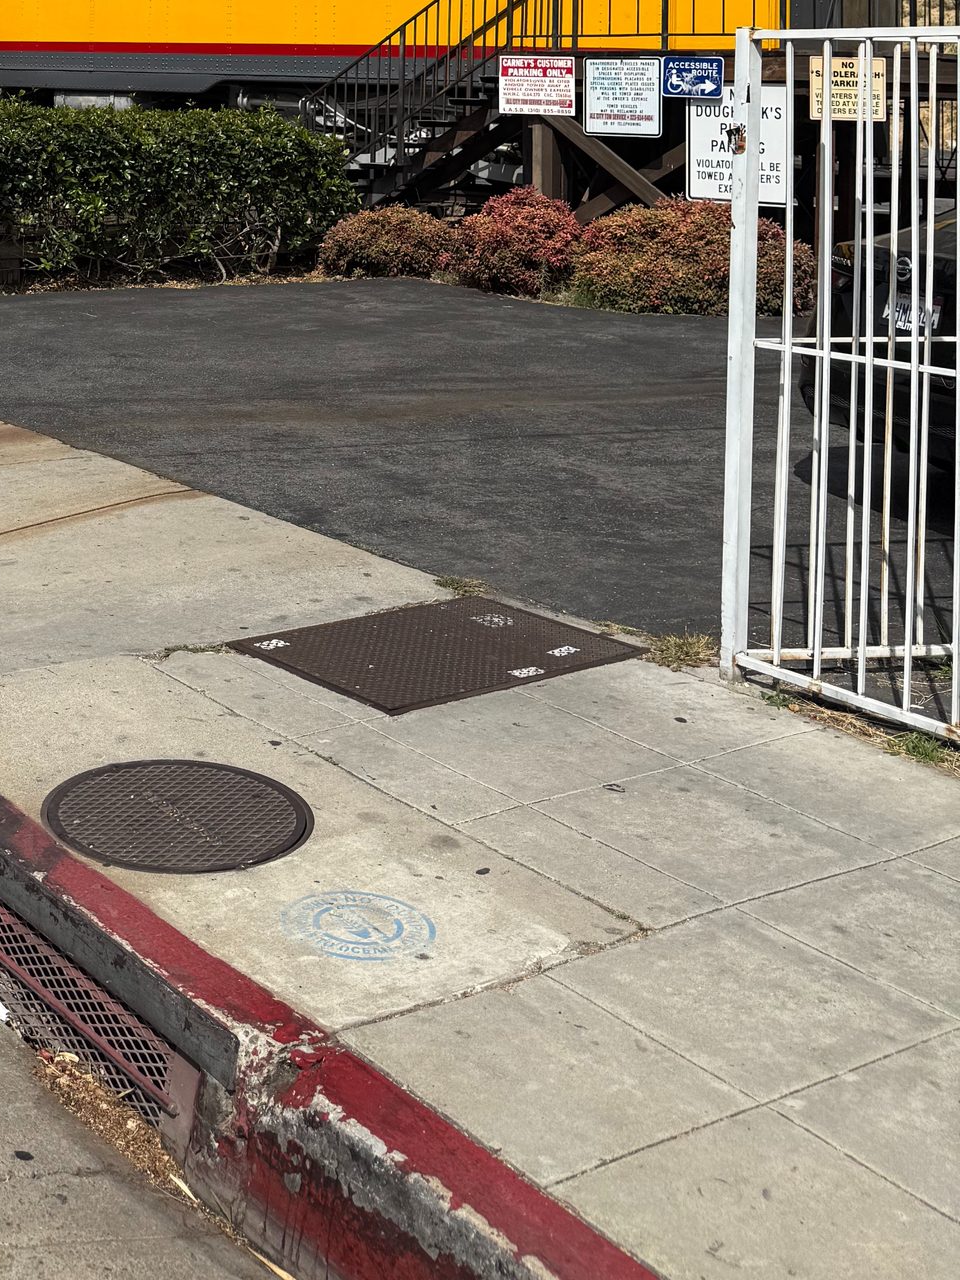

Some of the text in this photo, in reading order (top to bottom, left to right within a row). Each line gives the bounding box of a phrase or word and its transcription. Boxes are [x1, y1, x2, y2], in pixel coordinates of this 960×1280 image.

[502, 58, 572, 68] CARNEY'S CUSTOMER
[668, 61, 718, 70] ACCESSIBLE
[507, 68, 567, 77] PARKING ONLY
[691, 69, 718, 77] ROUTE
[696, 158, 733, 169] VIOLATO
[769, 162, 781, 172] BE
[696, 170, 725, 181] TOWED
